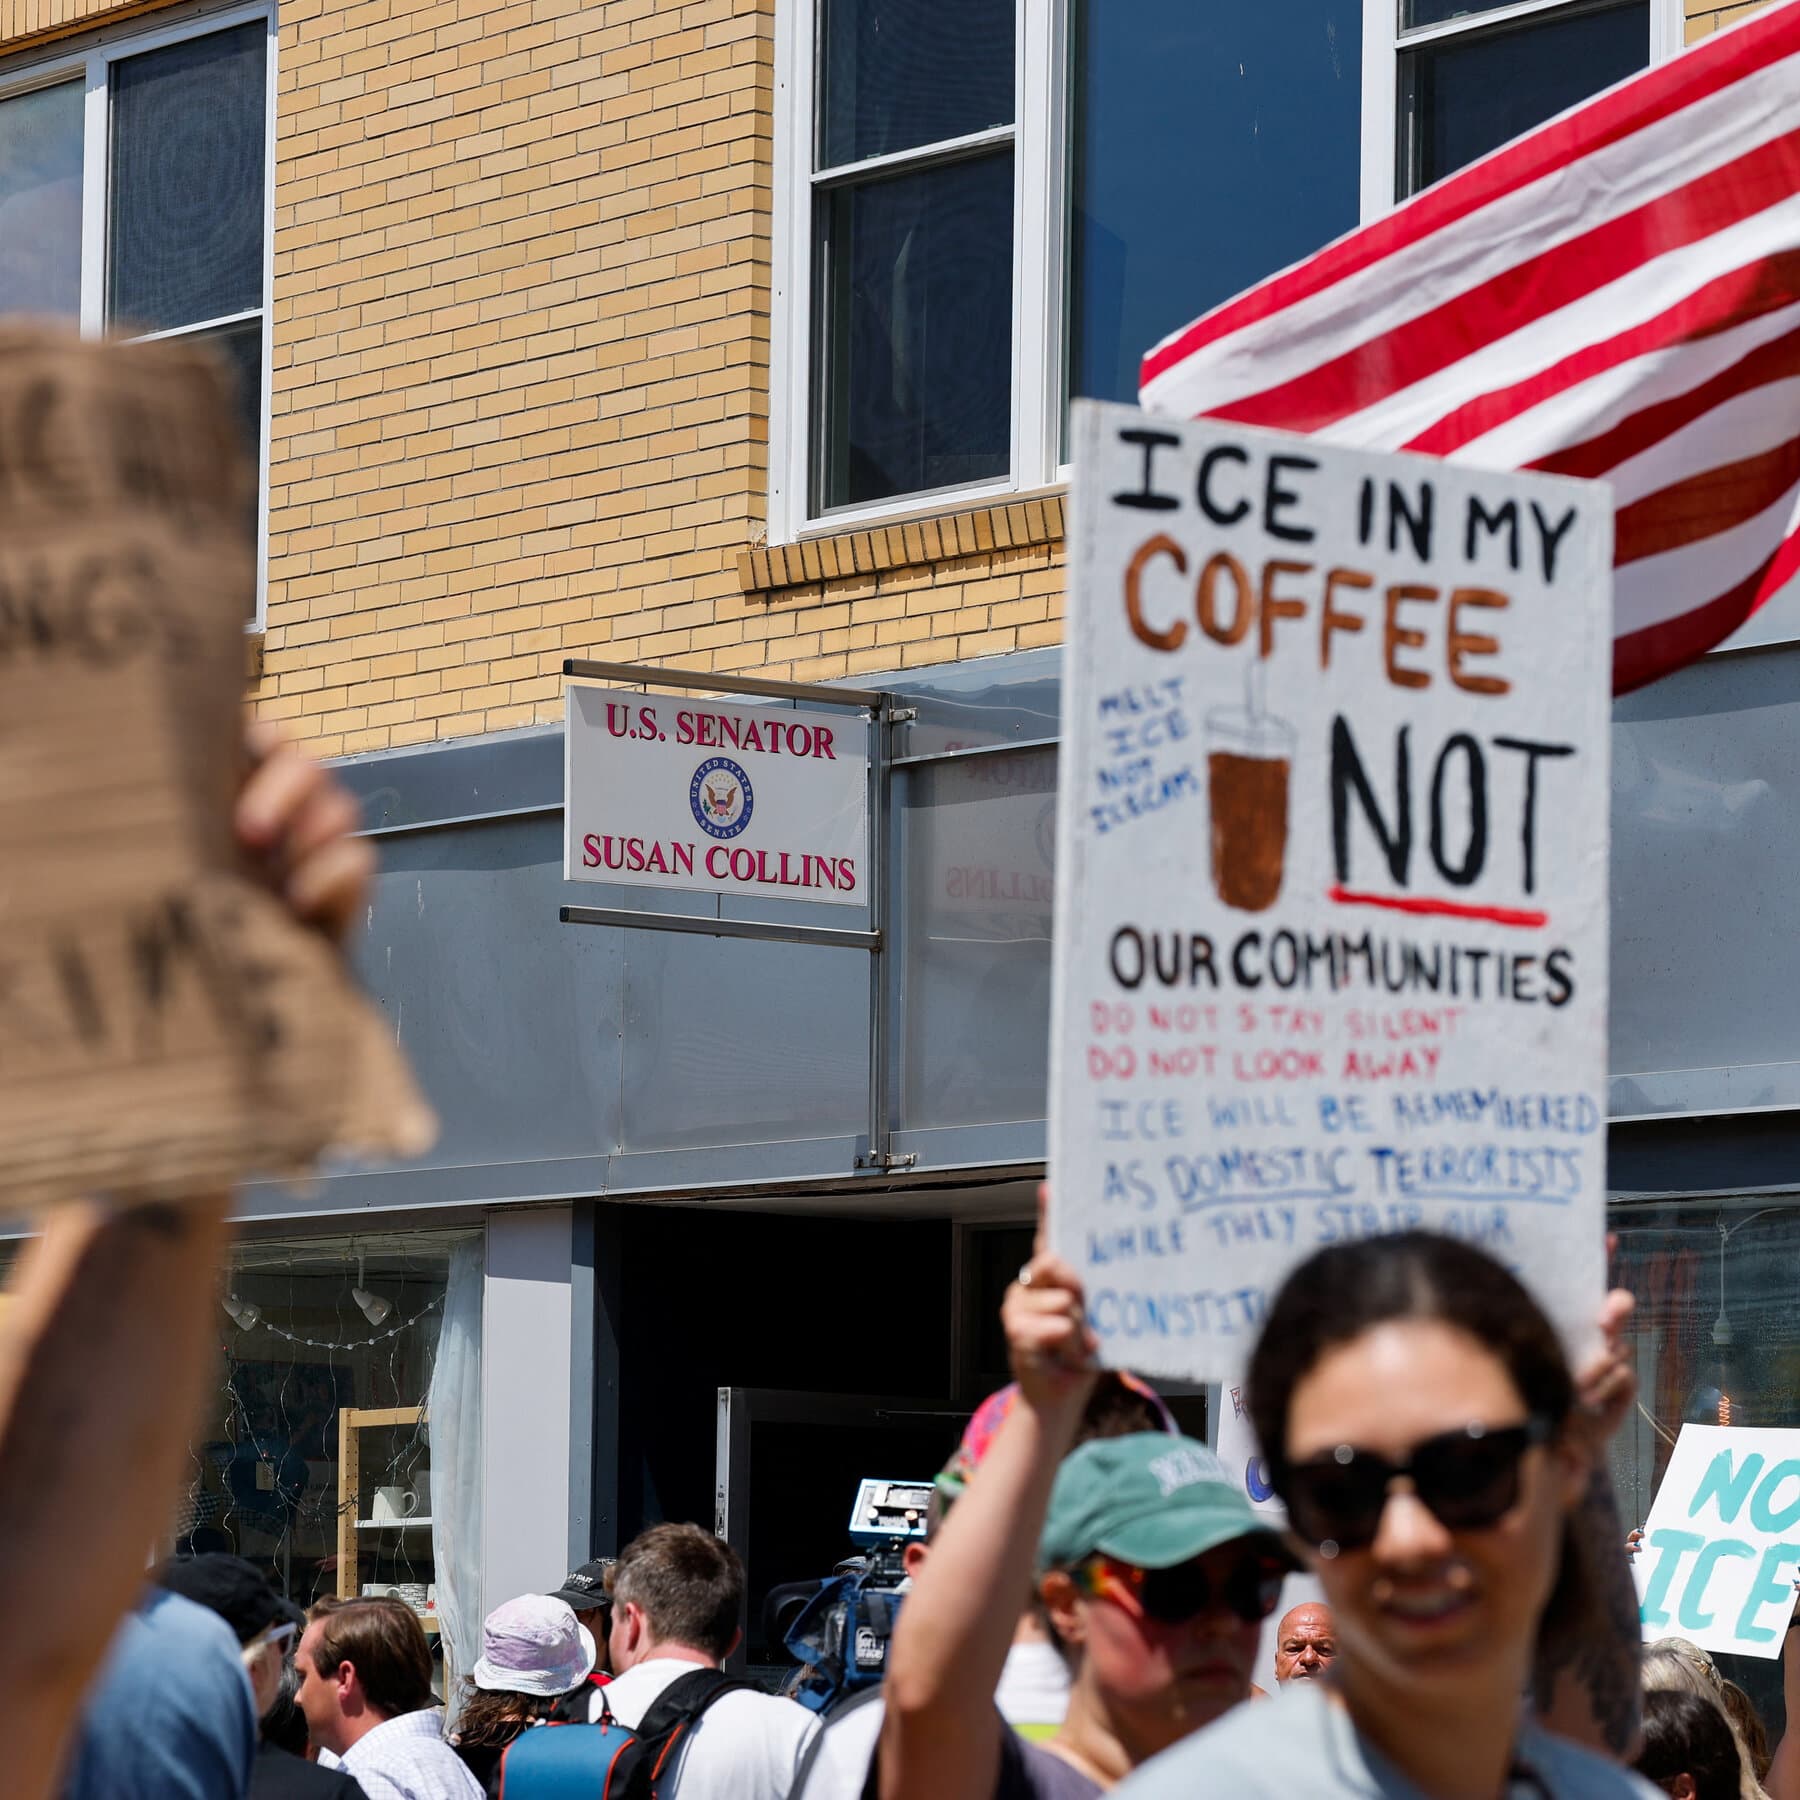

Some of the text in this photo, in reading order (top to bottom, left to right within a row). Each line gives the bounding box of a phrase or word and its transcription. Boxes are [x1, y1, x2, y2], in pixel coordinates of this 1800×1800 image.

[1112, 429, 1577, 584] ICE IN MY
[1124, 532, 1511, 696] COFFEE
[1098, 676, 1184, 719] MELT
[605, 703, 837, 760] U.S. SENATOR
[1106, 709, 1189, 757] ICE
[691, 760, 752, 801] UNITED STATES
[1099, 756, 1152, 794] NOT
[700, 820, 742, 838] SENATE
[1330, 713, 1576, 895] NOT
[582, 833, 856, 891] SUSAN COLLINS
[1109, 925, 1575, 1008] OUR COMMUNITIES
[1090, 1001, 1135, 1035] DO
[1148, 1003, 1217, 1035] NOT
[1345, 1006, 1466, 1041] SILENT
[1088, 1046, 1441, 1082] DO NOT LOOK AWAY
[1098, 1087, 1600, 1141] ICE WILL BE REMEMBERED
[1104, 1145, 1583, 1211] AS DOMESTIC TERRORISTS
[1087, 1202, 1515, 1265] WHILE THEY STRIP OUR
[1688, 1448, 1800, 1534] NO
[1640, 1528, 1800, 1644] ICE
